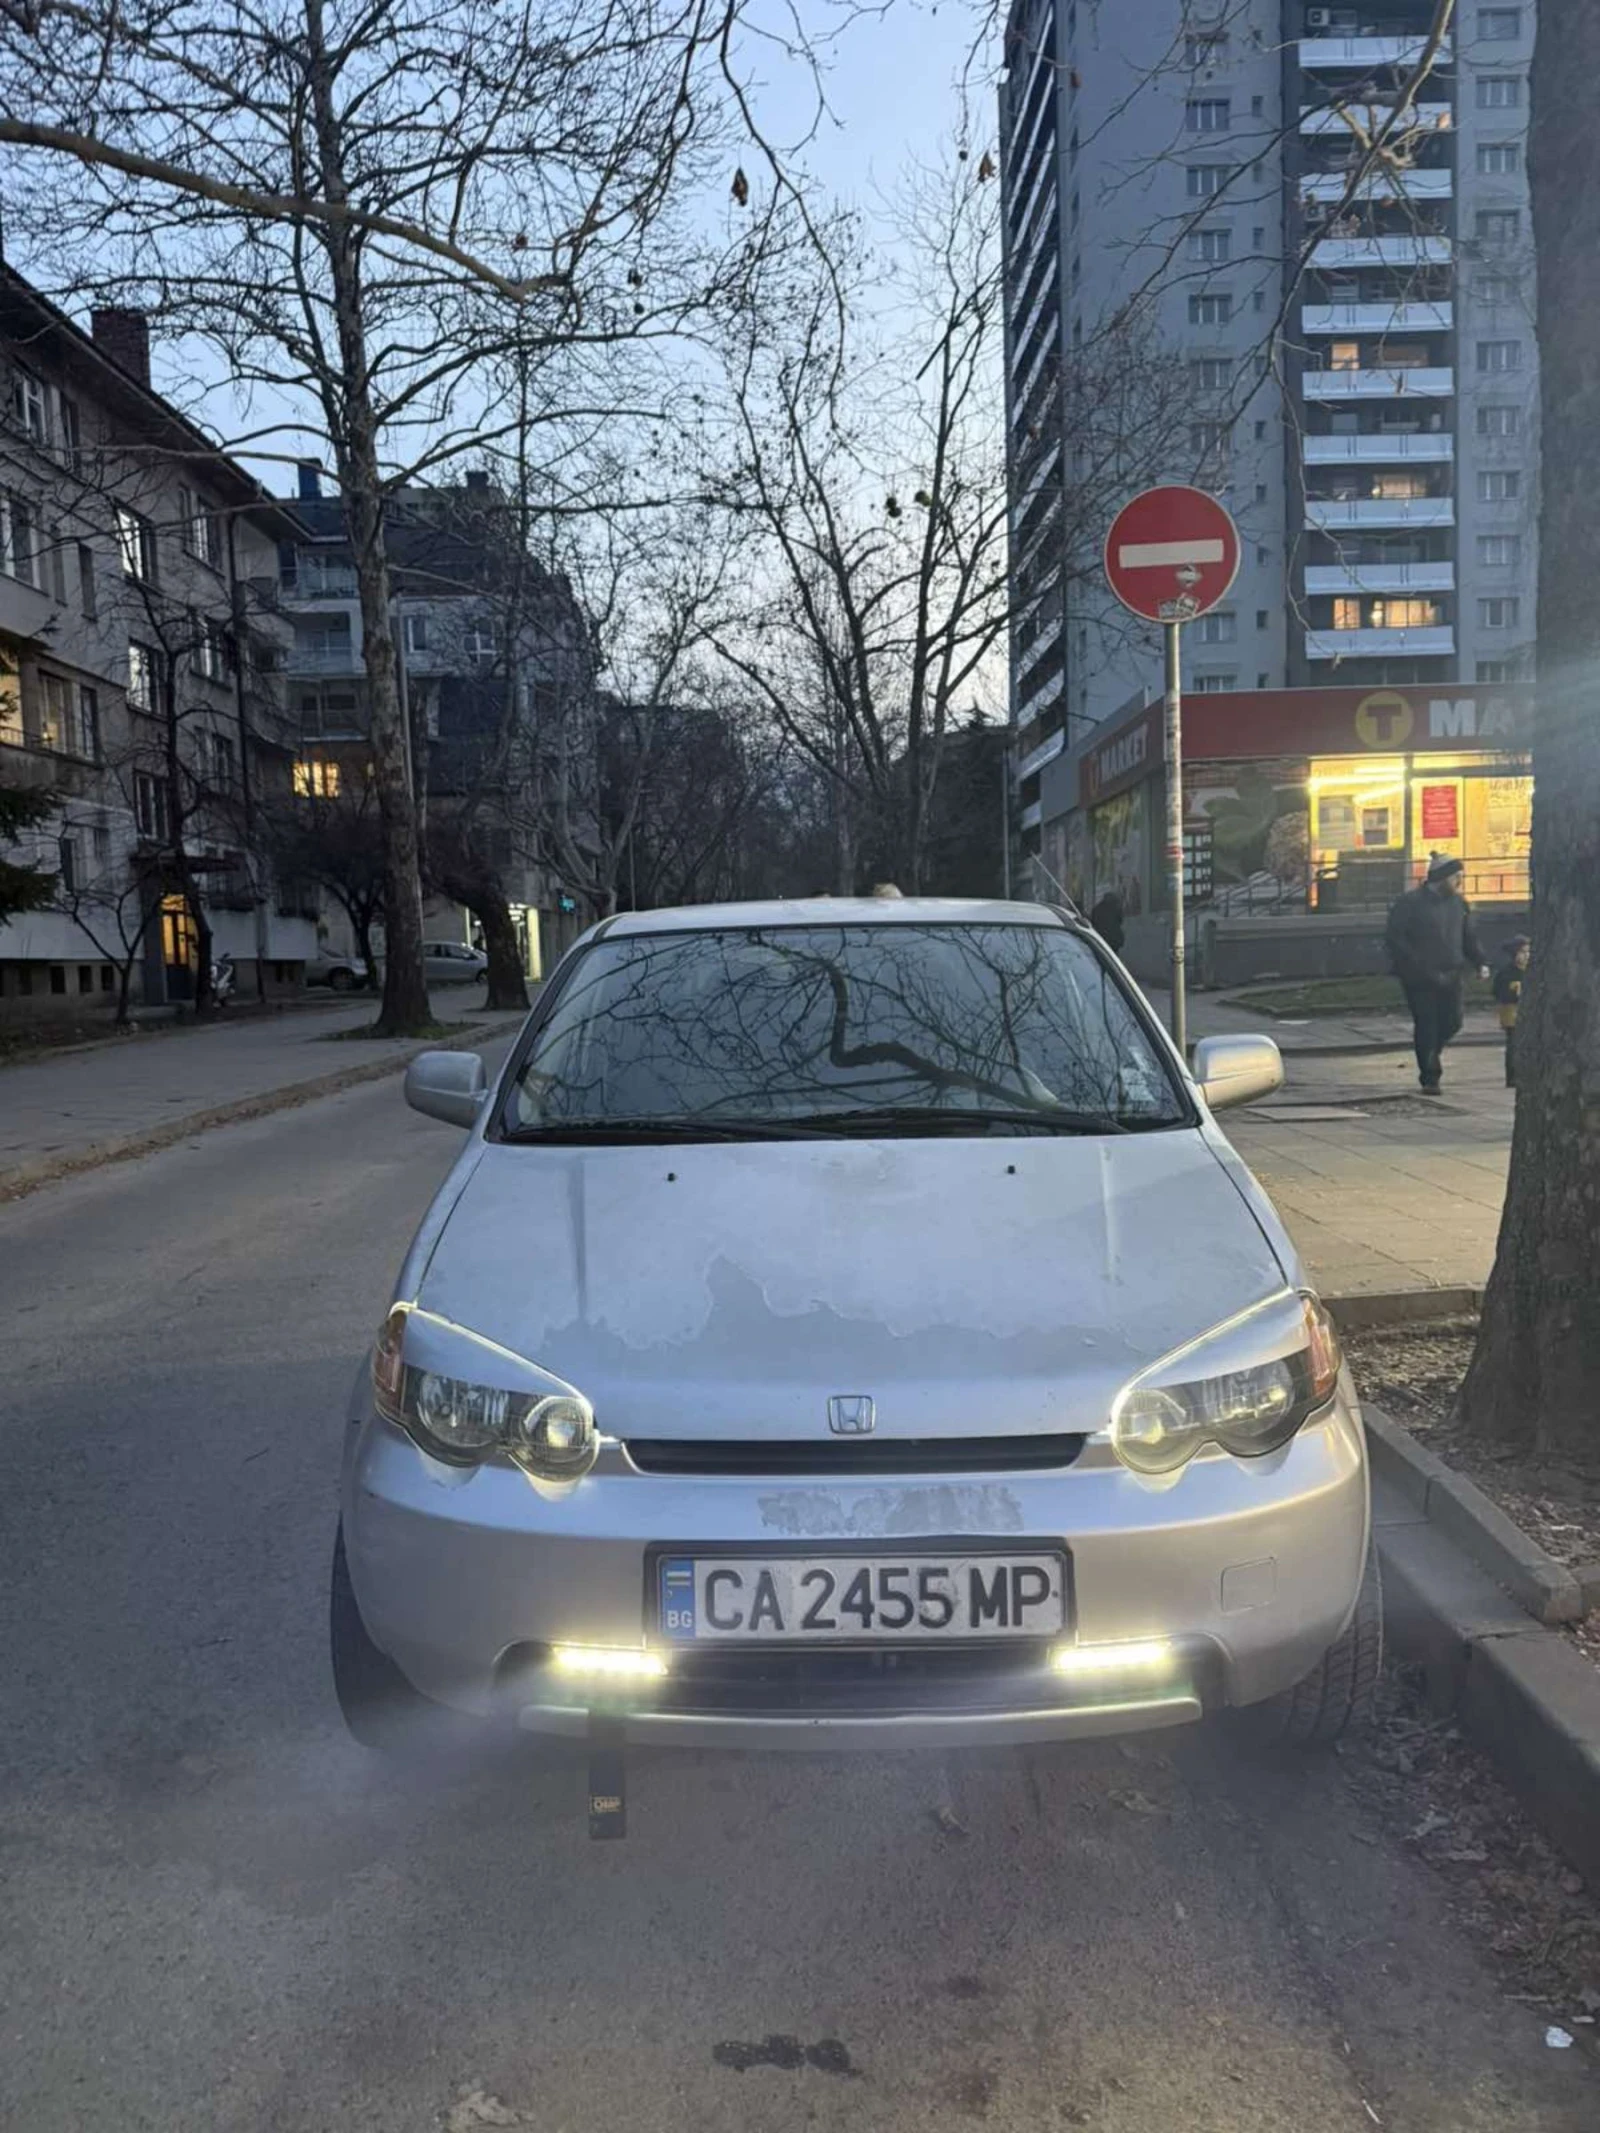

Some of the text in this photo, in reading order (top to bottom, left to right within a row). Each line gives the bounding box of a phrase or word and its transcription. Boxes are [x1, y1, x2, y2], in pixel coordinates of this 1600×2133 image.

[1366, 699, 1533, 741] T MA
[1101, 721, 1148, 784] MARKET
[667, 1610, 692, 1628] BG
[705, 1566, 1050, 1631] CA 2455 MP
